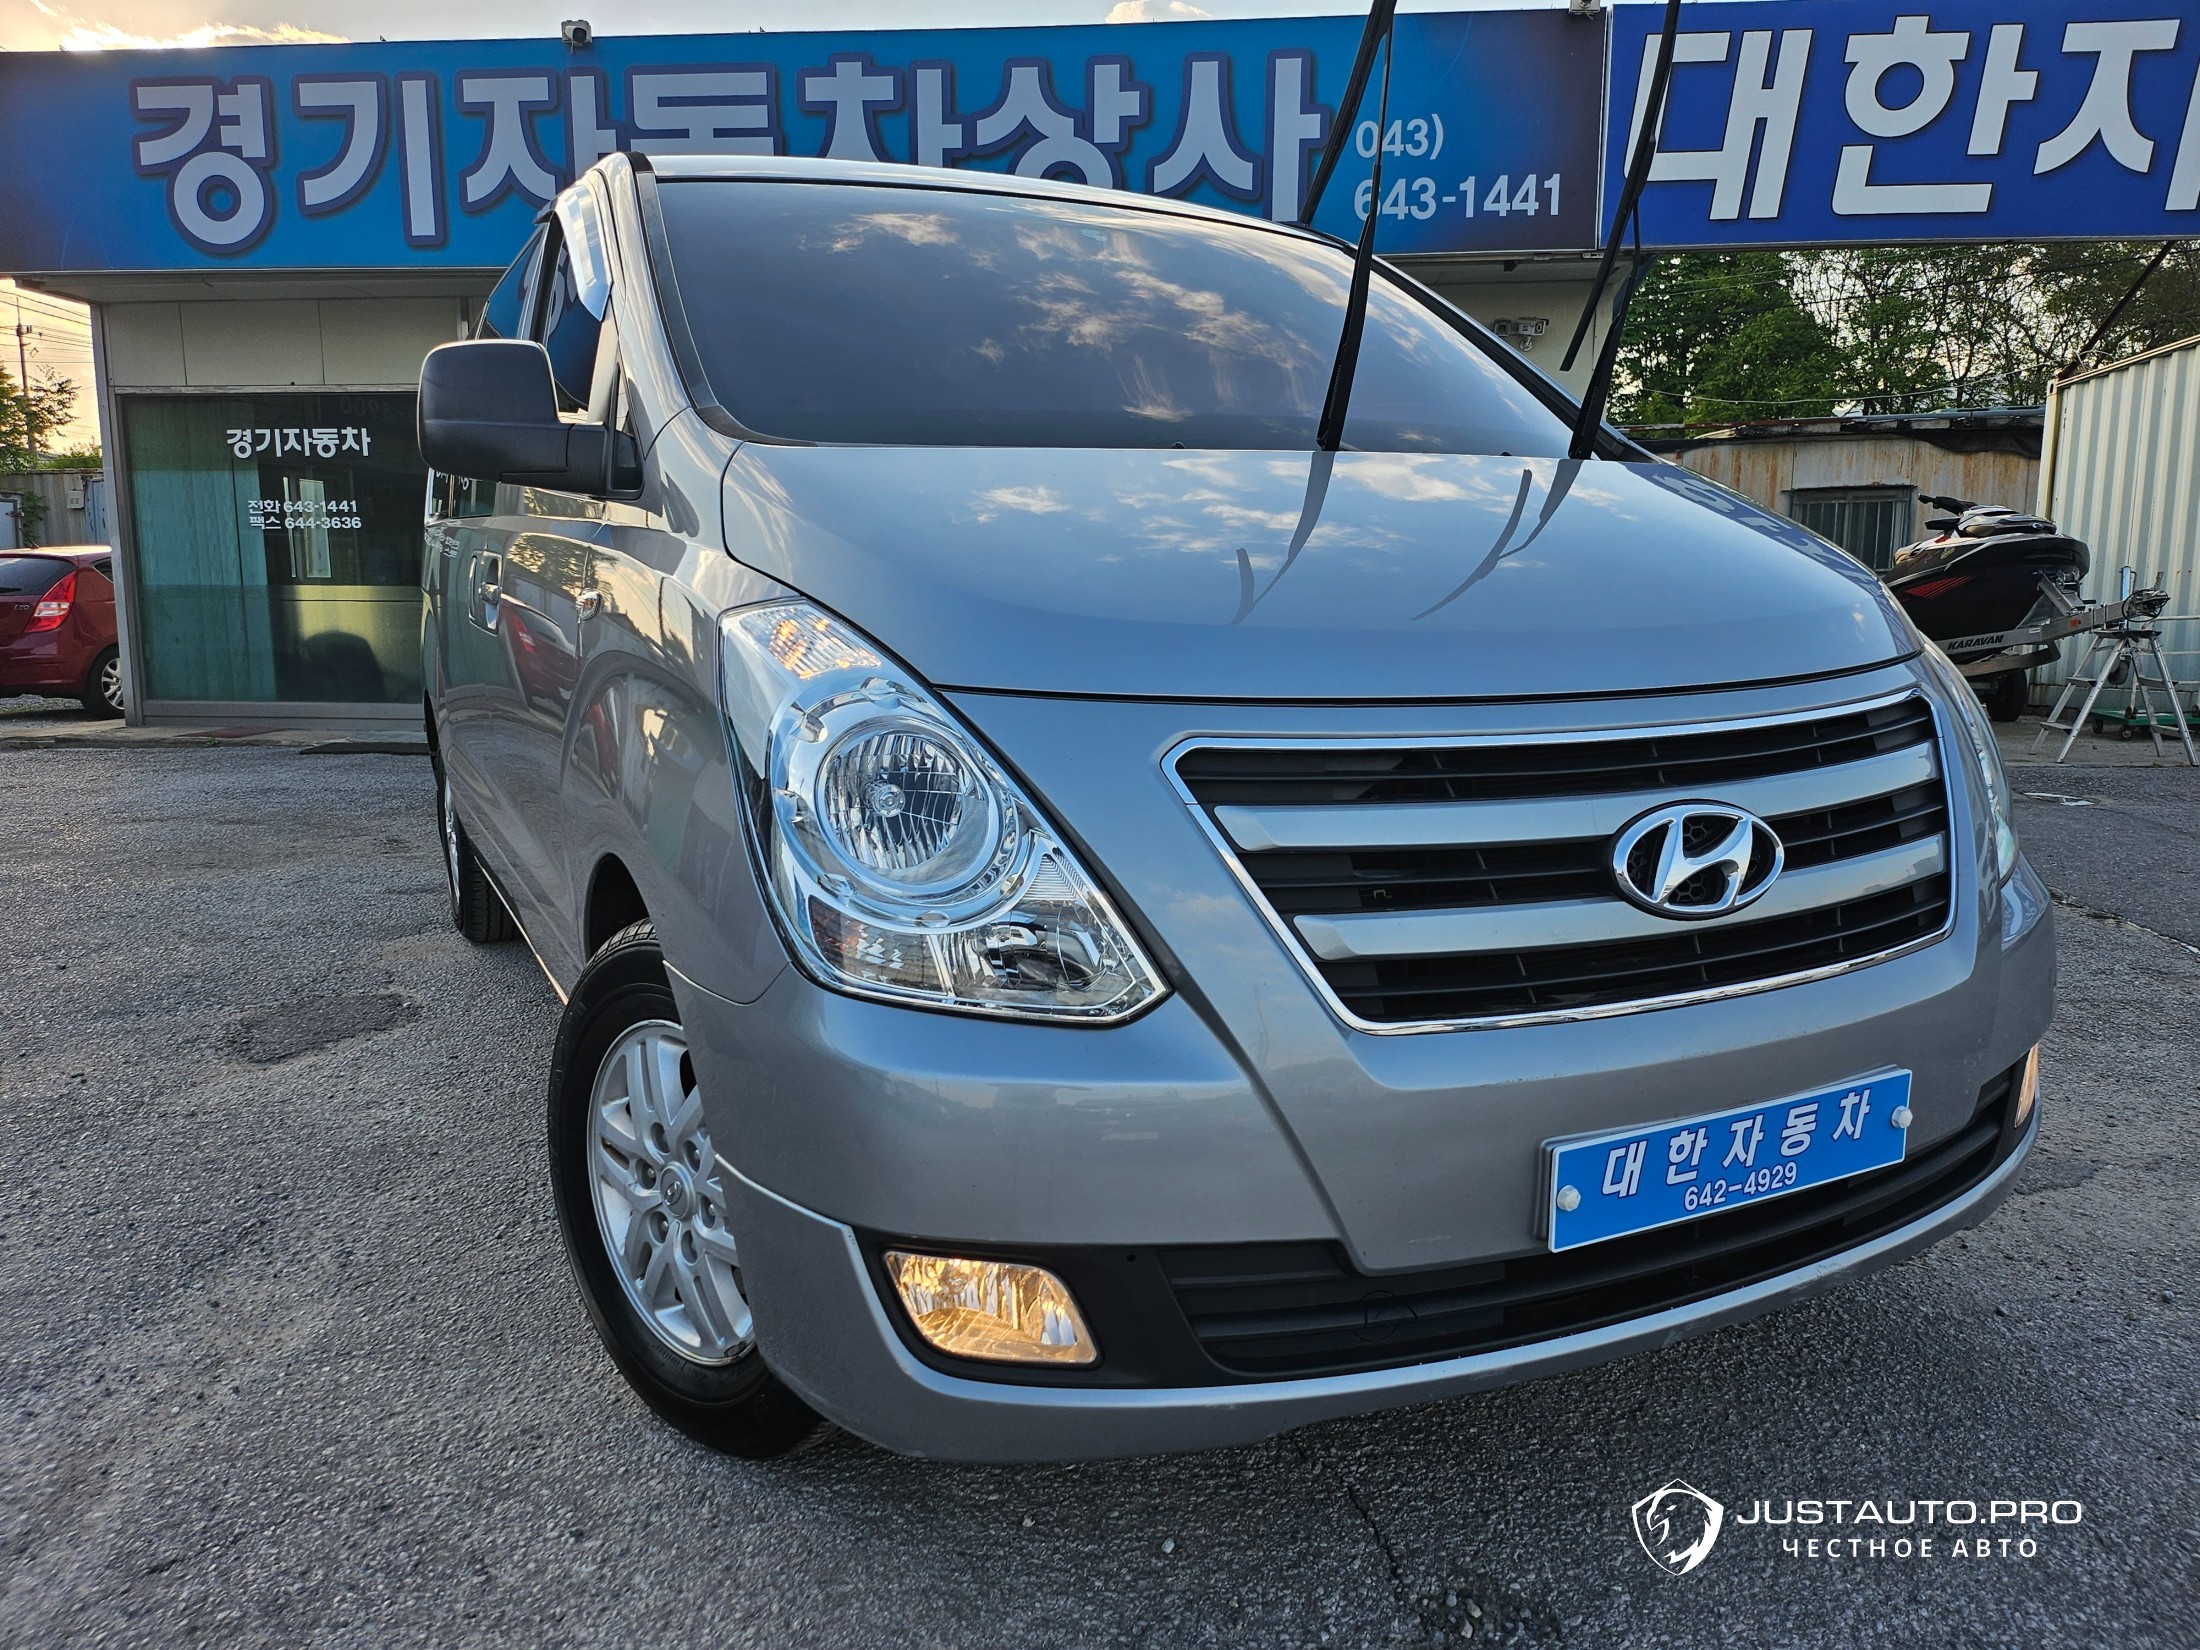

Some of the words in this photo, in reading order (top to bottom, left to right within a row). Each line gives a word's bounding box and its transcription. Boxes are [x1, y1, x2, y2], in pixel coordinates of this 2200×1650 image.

[1355, 113, 1444, 160] 043)
[1354, 173, 1560, 221] 643-1441
[226, 426, 371, 459] 경기자동차
[248, 499, 281, 514] 전화
[283, 499, 358, 513] 643-1441
[249, 515, 282, 530] 팩스
[284, 515, 362, 529] 644-3636
[1947, 634, 2004, 650] KARAVAN
[1684, 1161, 1798, 1212] 642-4929
